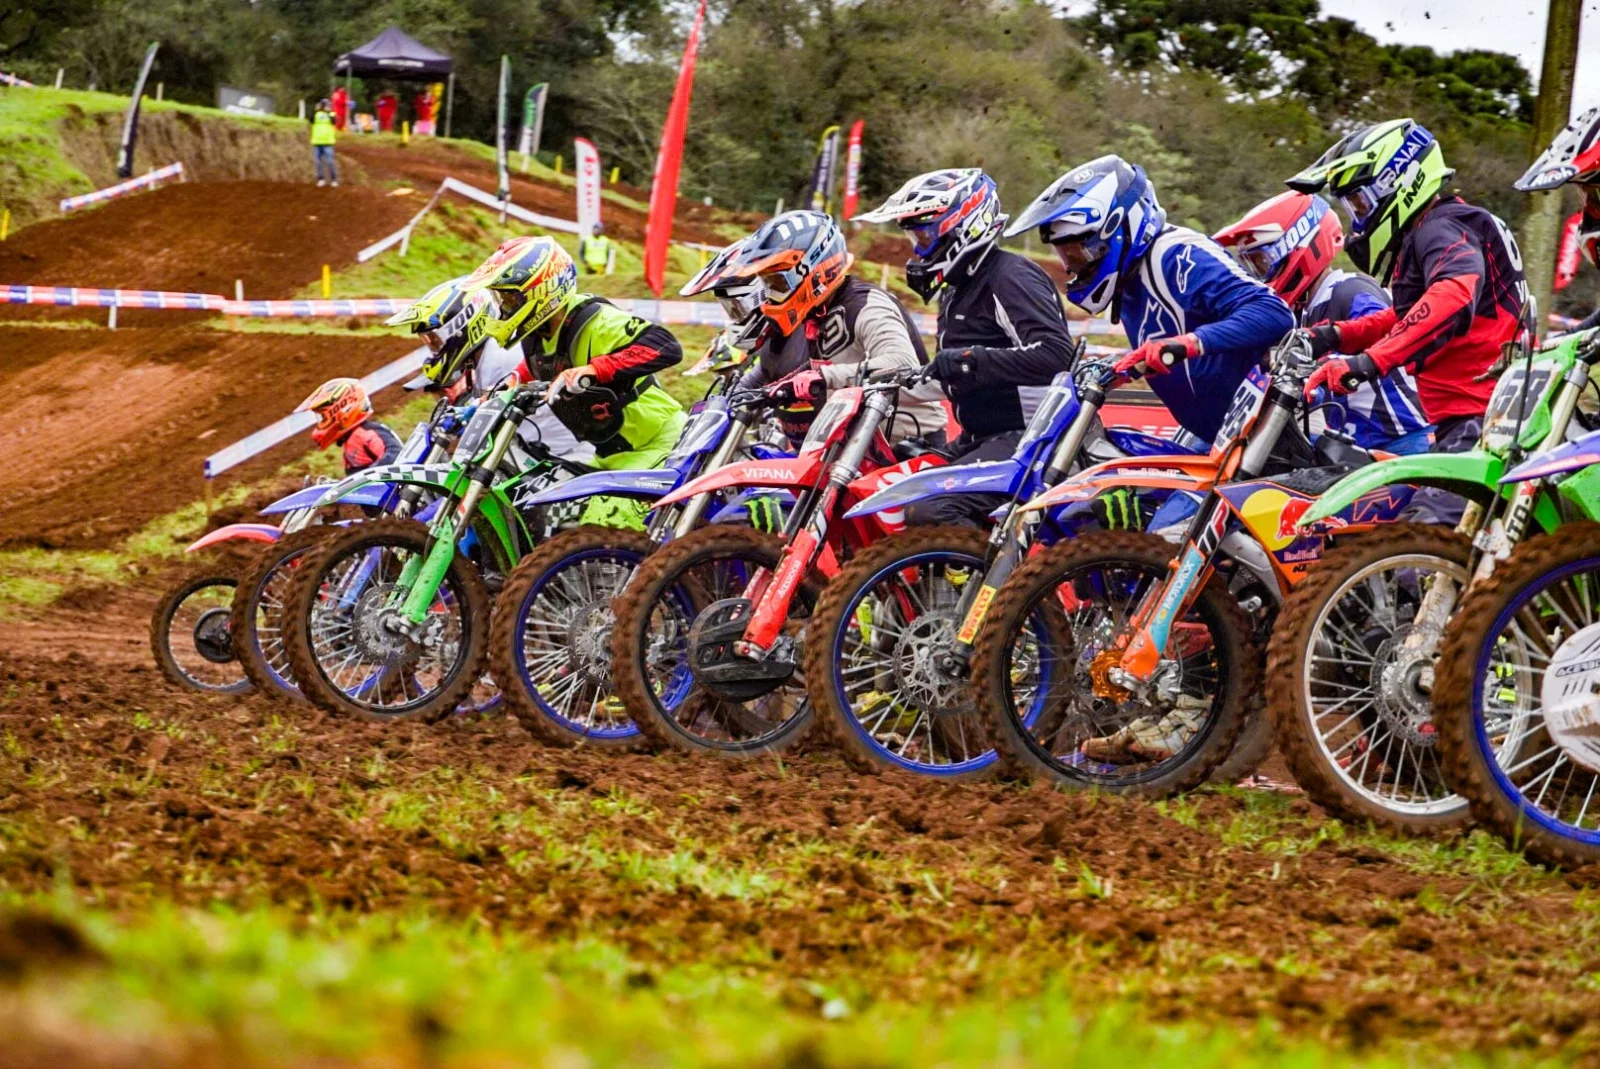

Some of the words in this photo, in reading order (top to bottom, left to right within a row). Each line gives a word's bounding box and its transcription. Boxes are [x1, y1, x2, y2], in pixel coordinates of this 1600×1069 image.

[1402, 168, 1426, 209] IMS
[1531, 167, 1573, 187] Airoh
[1278, 206, 1323, 260] 100%
[328, 394, 358, 417] 100%
[742, 467, 796, 481] VITANA
